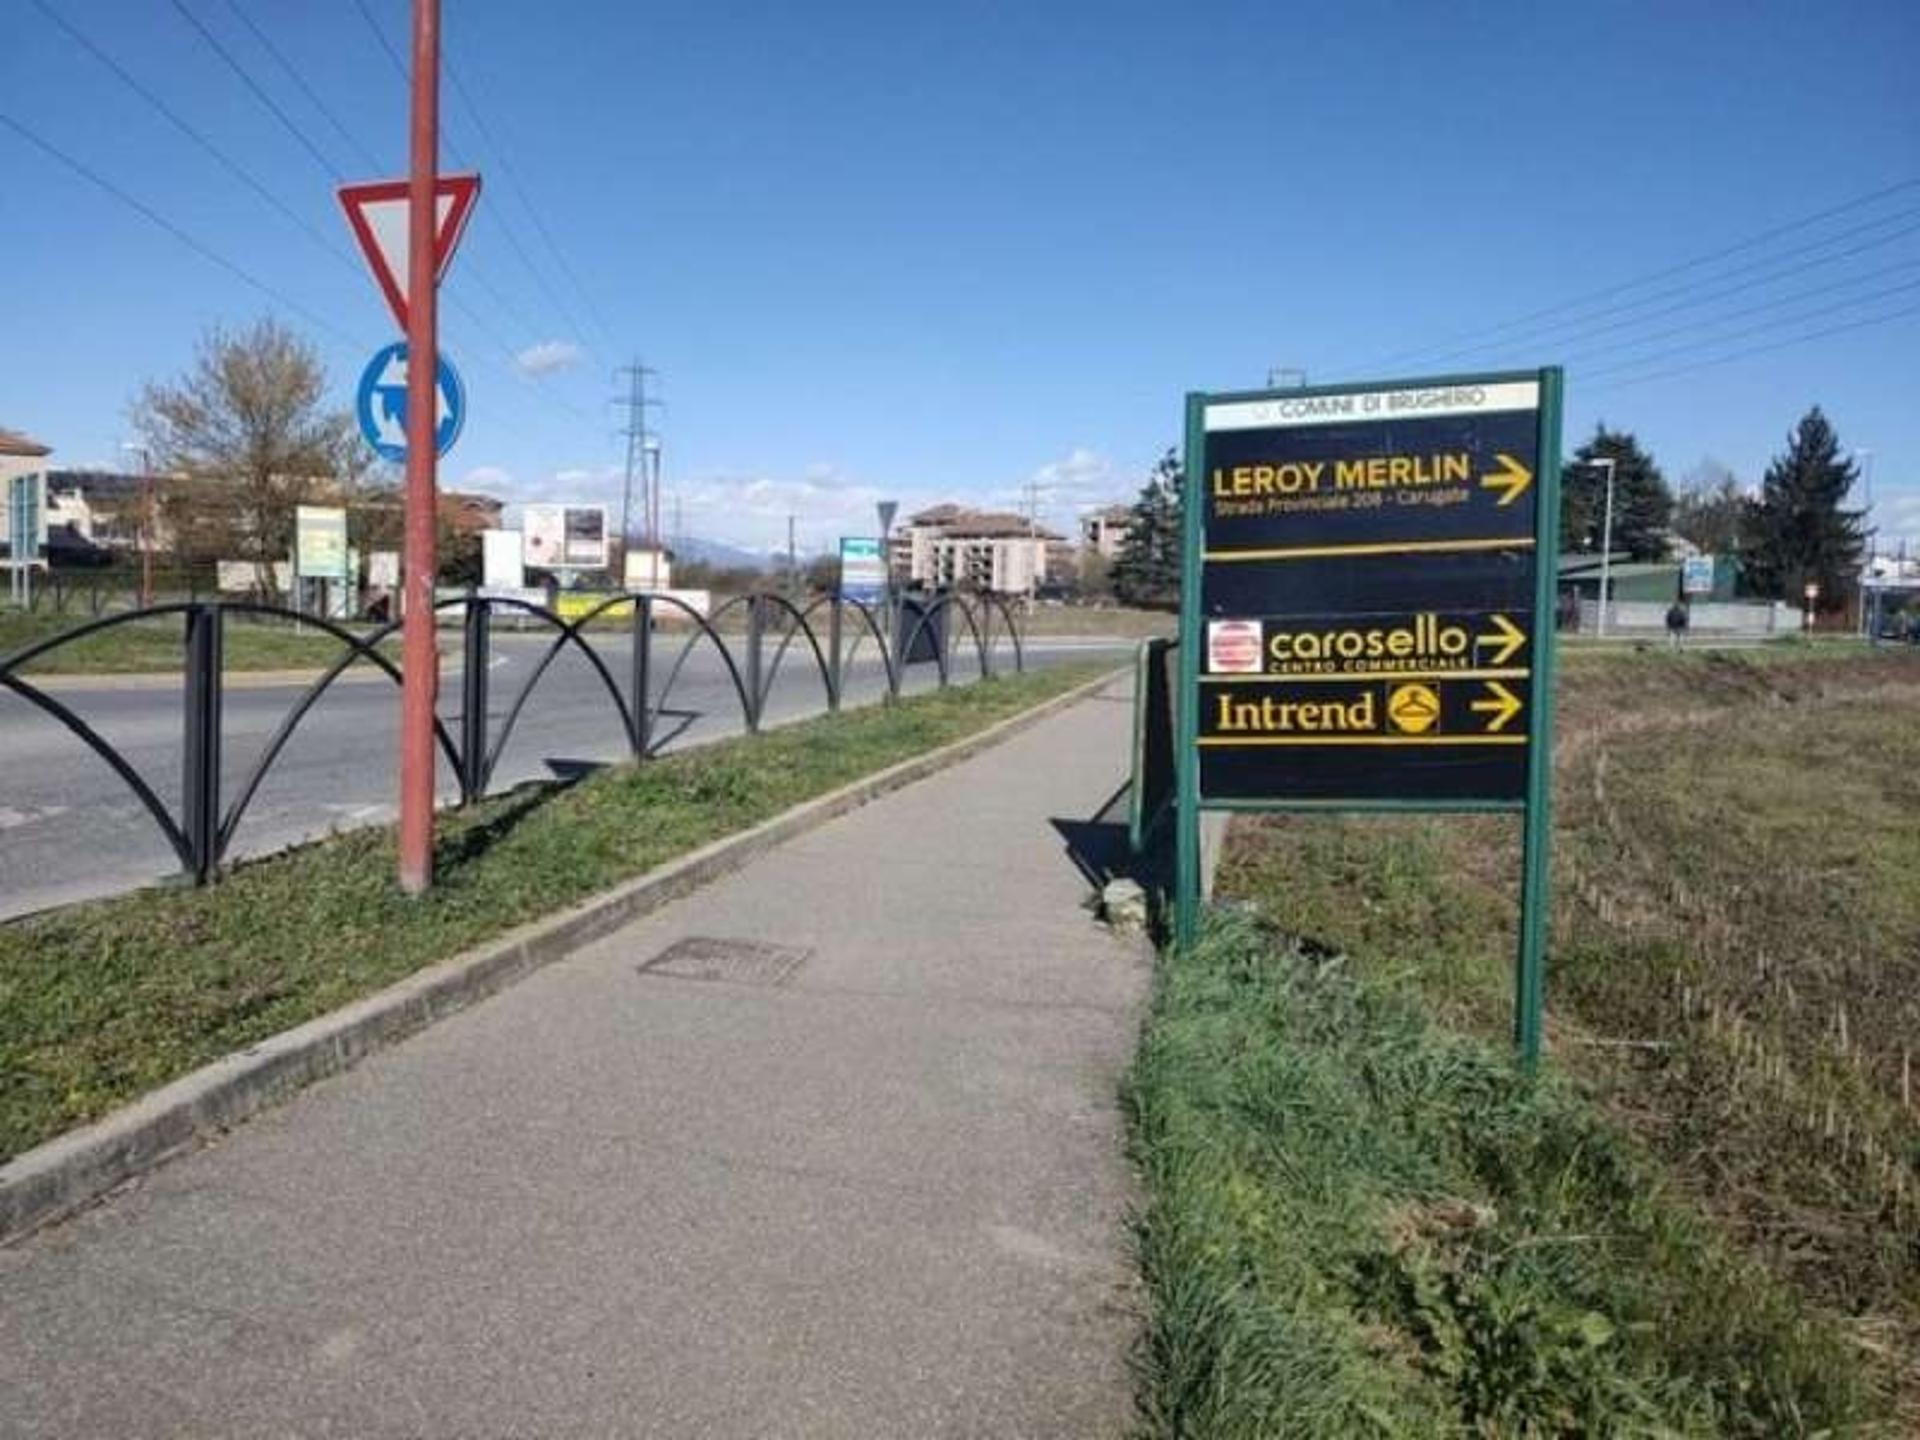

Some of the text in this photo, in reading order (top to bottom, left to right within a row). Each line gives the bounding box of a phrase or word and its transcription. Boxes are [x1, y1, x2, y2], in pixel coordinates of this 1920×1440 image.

[1280, 387, 1486, 419] COMUNE DI BRUGHERIO
[1214, 454, 1469, 496] LEROY MERLIN
[1270, 614, 1467, 659] carosello
[1269, 660, 1335, 673] CENTRO
[1217, 692, 1375, 730] Intrend
